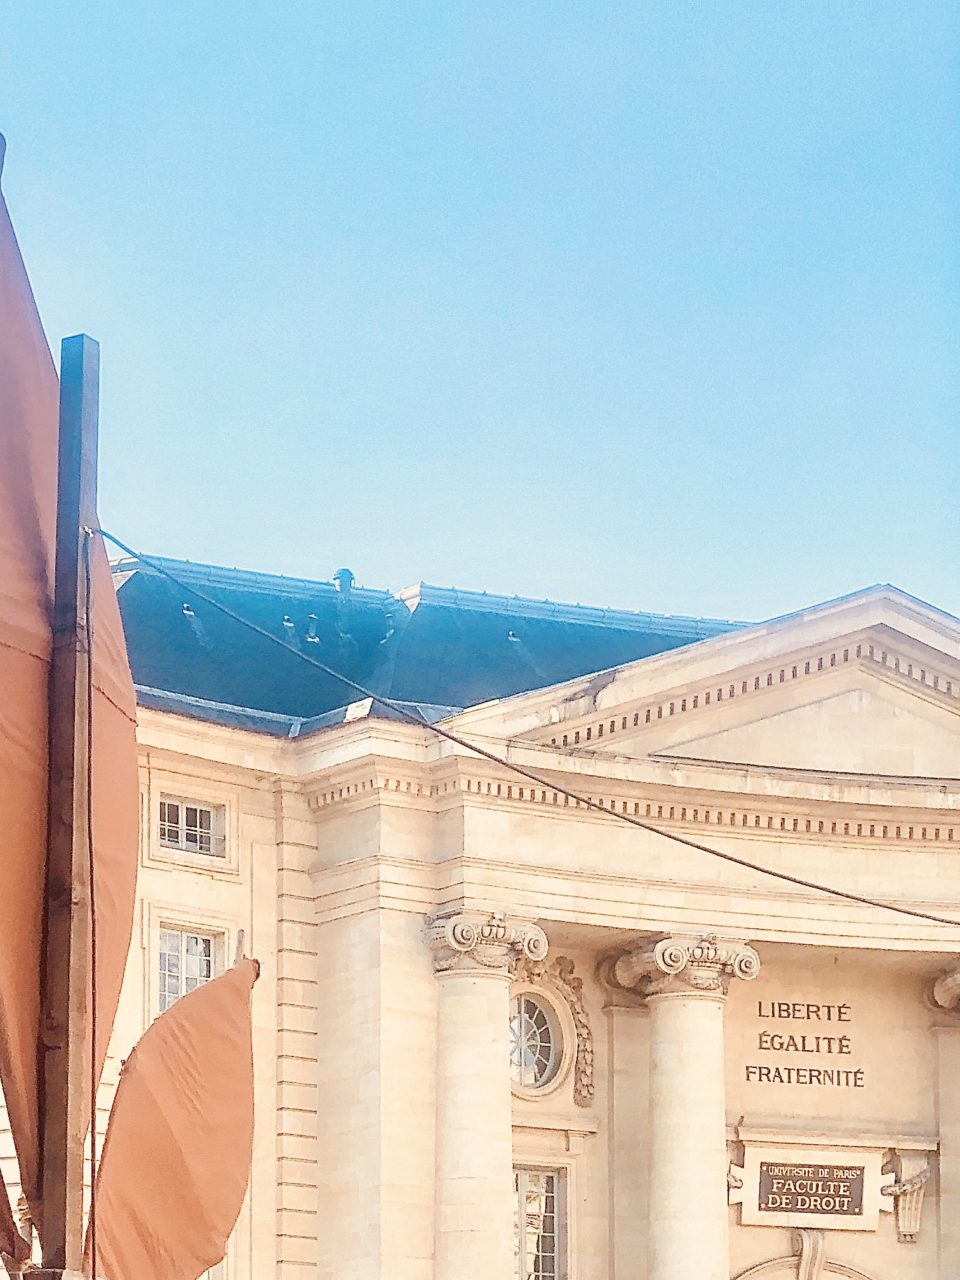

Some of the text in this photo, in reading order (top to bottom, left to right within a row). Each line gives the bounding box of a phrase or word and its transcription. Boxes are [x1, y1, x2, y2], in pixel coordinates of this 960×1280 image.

[758, 1001, 851, 1022] LIBERTÉ
[758, 1031, 851, 1054] ÉGALITÉ
[745, 1066, 865, 1088] FRATERNITÉ
[818, 1169, 830, 1178] DE
[833, 1169, 857, 1179] PARIS
[771, 1180, 851, 1196] FACULTE
[767, 1195, 852, 1211] DE DROIT
